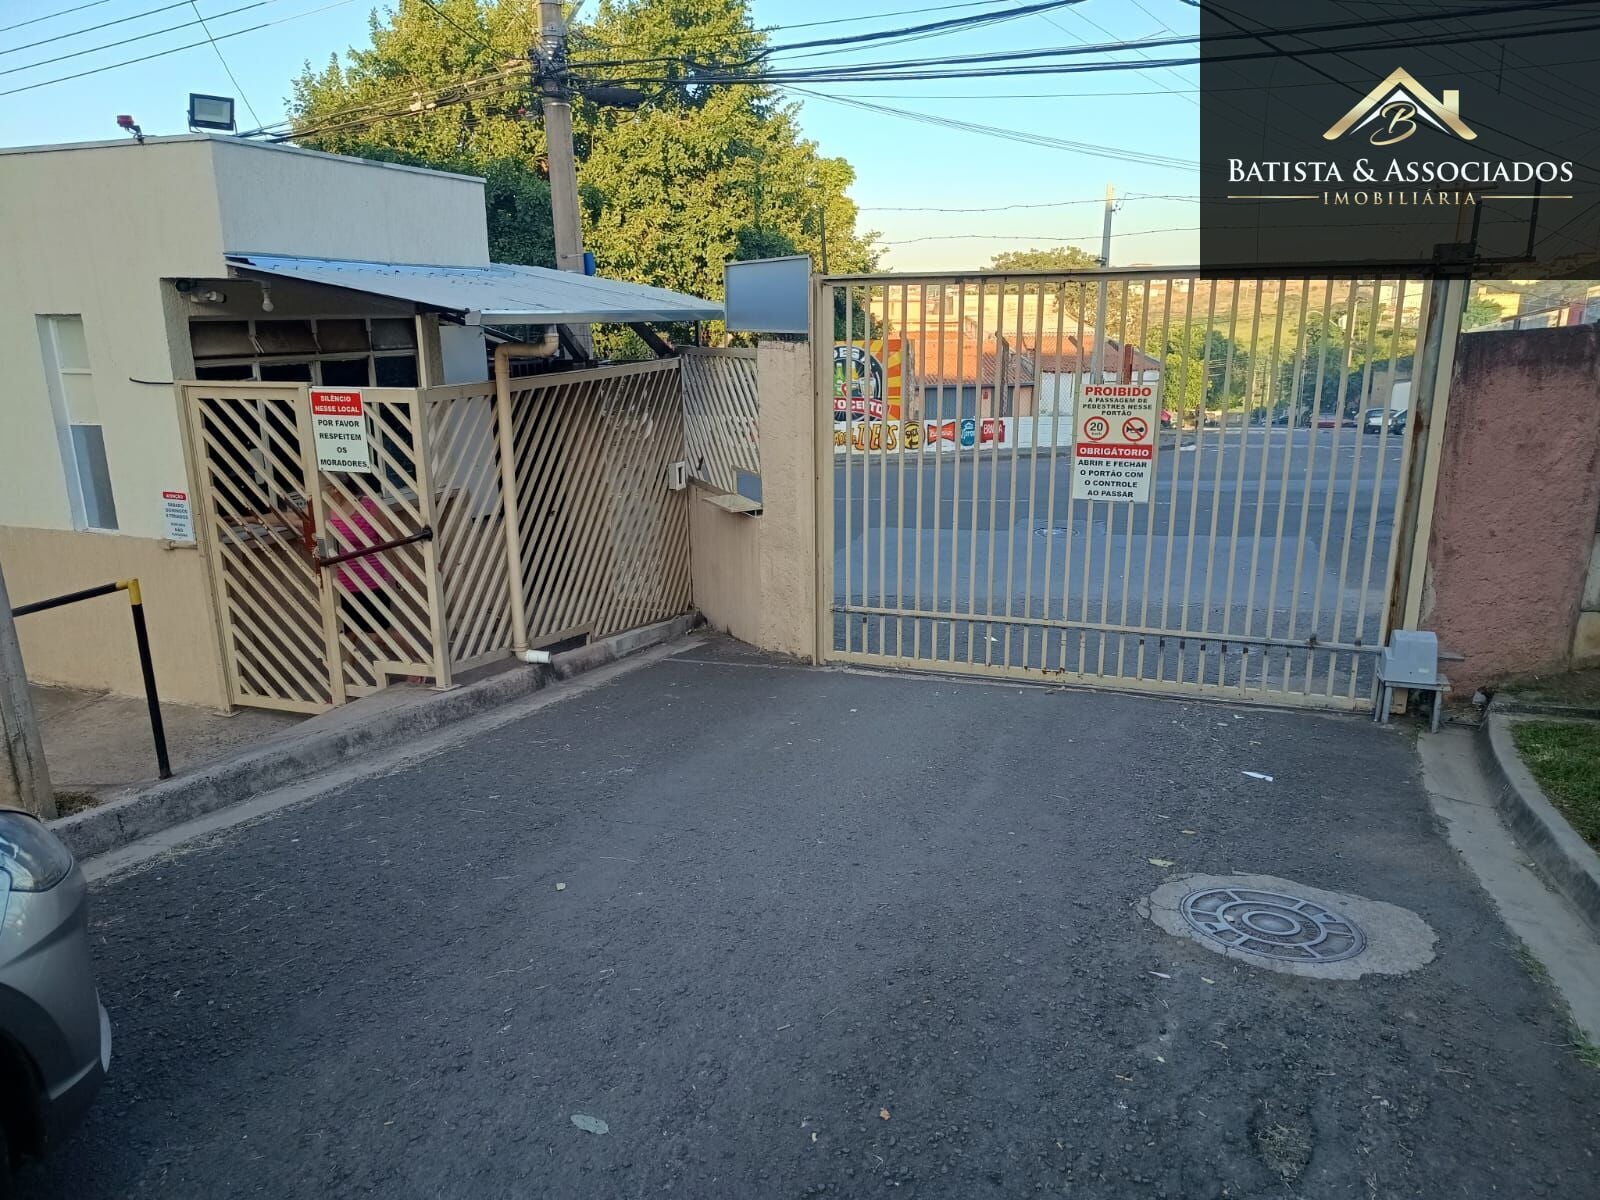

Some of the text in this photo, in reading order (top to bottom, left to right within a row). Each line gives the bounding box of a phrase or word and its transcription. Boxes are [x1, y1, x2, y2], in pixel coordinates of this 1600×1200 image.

[1085, 386, 1152, 397] PROIBIDO
[320, 394, 351, 402] SILÊNCIO
[318, 419, 359, 428] POR FAVOR
[1090, 422, 1104, 432] 20
[320, 433, 361, 441] RESPEITEM
[1078, 459, 1104, 467] ABRIR
[1088, 470, 1123, 478] PORTÃO
[1092, 480, 1138, 488] CONTROLE
[1101, 490, 1134, 498] PASSAR
